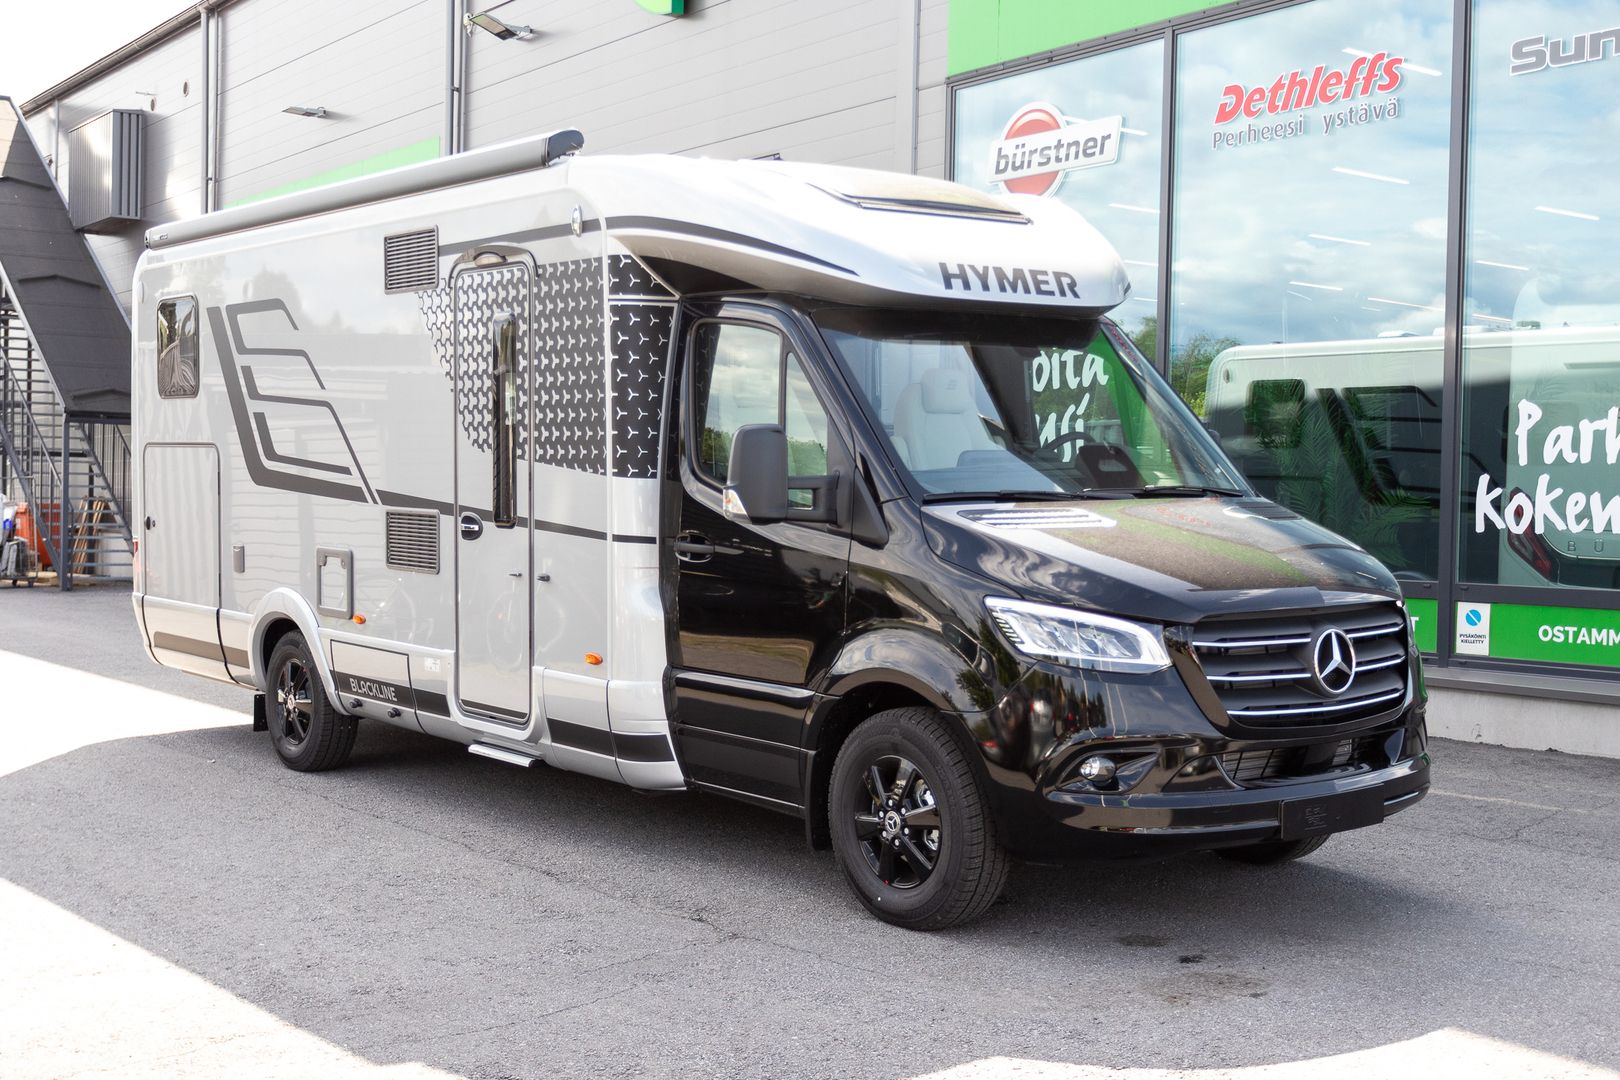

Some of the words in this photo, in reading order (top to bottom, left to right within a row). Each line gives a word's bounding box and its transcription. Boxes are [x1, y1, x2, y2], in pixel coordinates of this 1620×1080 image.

[1214, 51, 1405, 124] Dethleffs
[1212, 114, 1304, 149] Perheesi
[1323, 97, 1399, 136] ystävä
[995, 133, 1112, 175] bürstner
[938, 262, 1080, 299] HYMER
[349, 677, 398, 702] BLACKLINE
